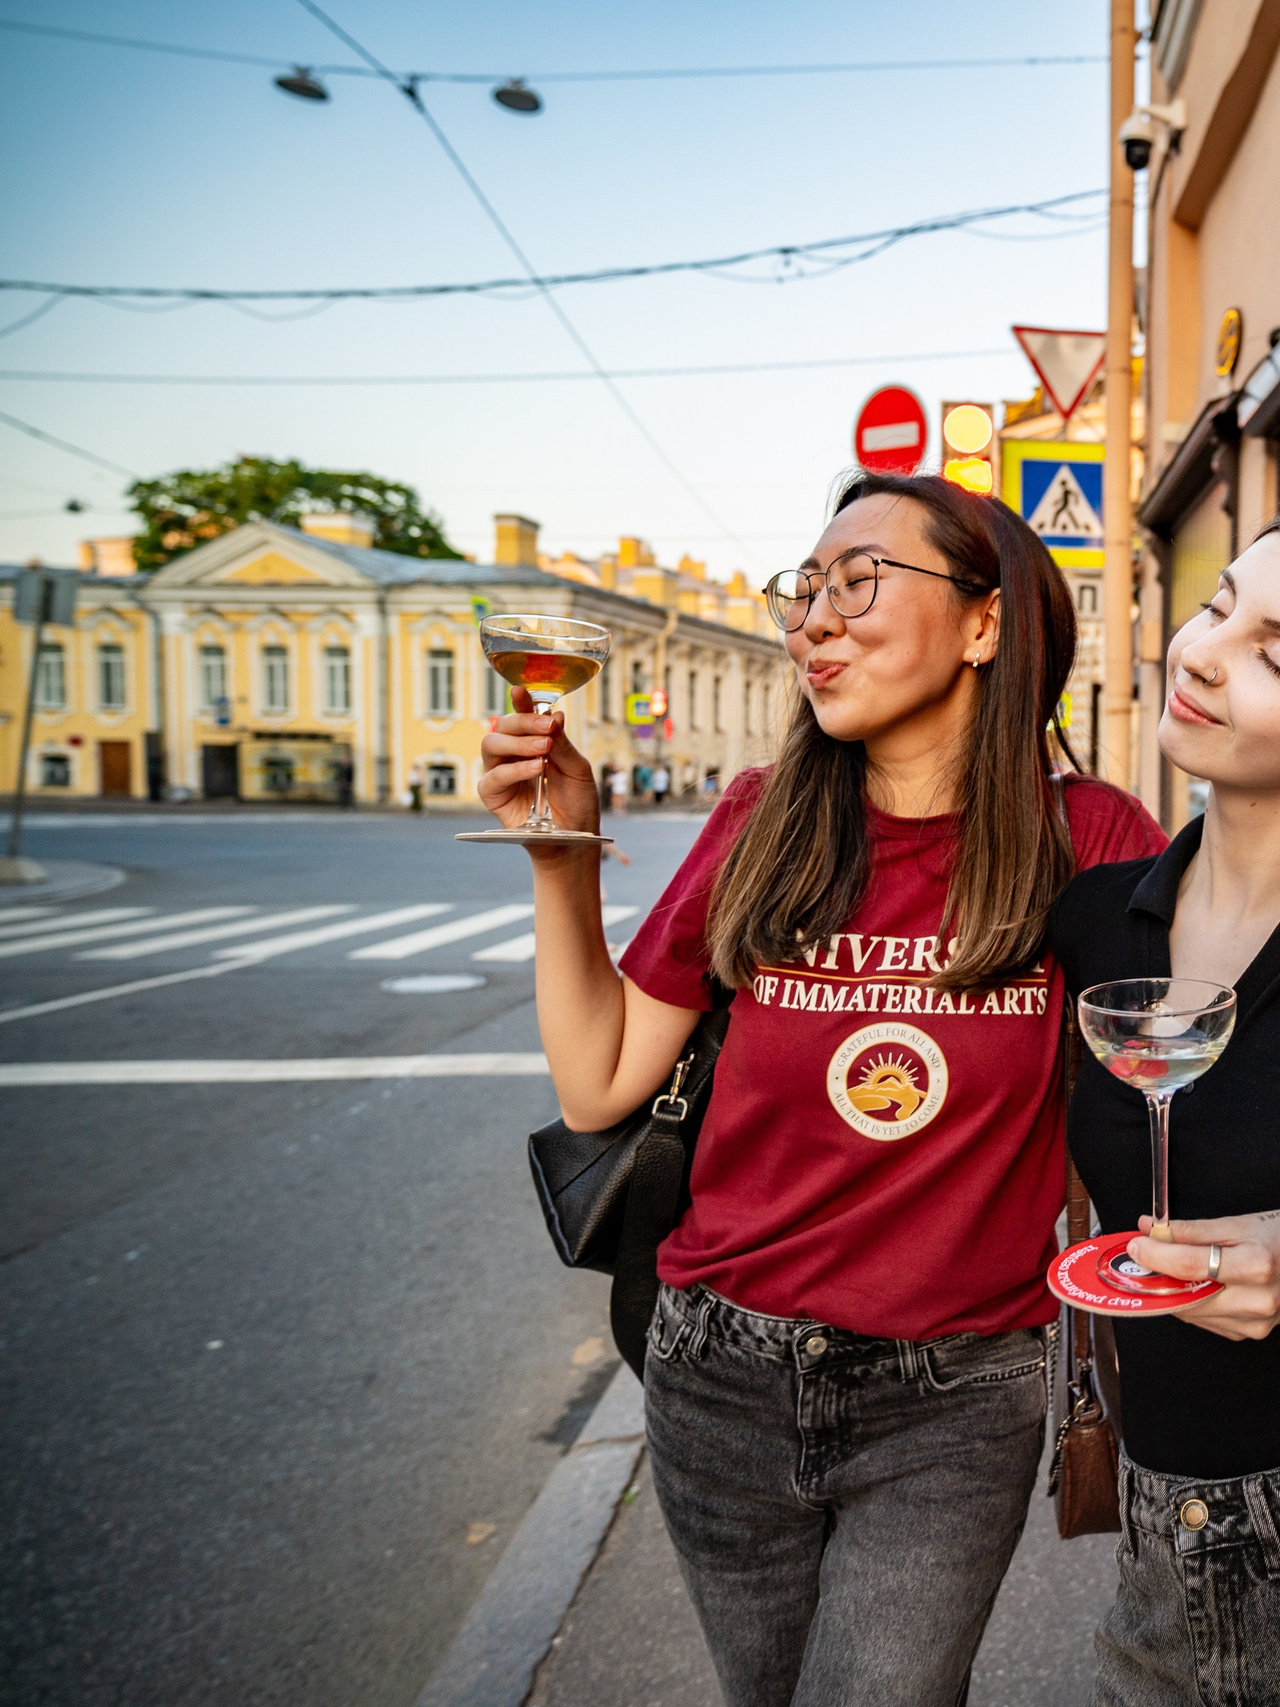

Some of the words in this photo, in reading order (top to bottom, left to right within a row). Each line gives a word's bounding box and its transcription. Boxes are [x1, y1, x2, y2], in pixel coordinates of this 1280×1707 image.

[753, 974, 779, 1006] OF
[778, 978, 976, 1014] IMMATERIAL
[980, 986, 1048, 1015] ARTS
[836, 1029, 884, 1068] GRATEFUL
[886, 1027, 907, 1038] FOR
[908, 1033, 926, 1050] ALL
[925, 1046, 941, 1070] AND
[834, 1091, 846, 1111] ALL
[846, 1107, 870, 1128] THAT
[871, 1123, 881, 1135] IS
[881, 1125, 902, 1137] YET
[902, 1119, 918, 1133] TO
[918, 1093, 941, 1121] COME
[1057, 1270, 1106, 1305] разбитых
[1107, 1298, 1143, 1308] бар
